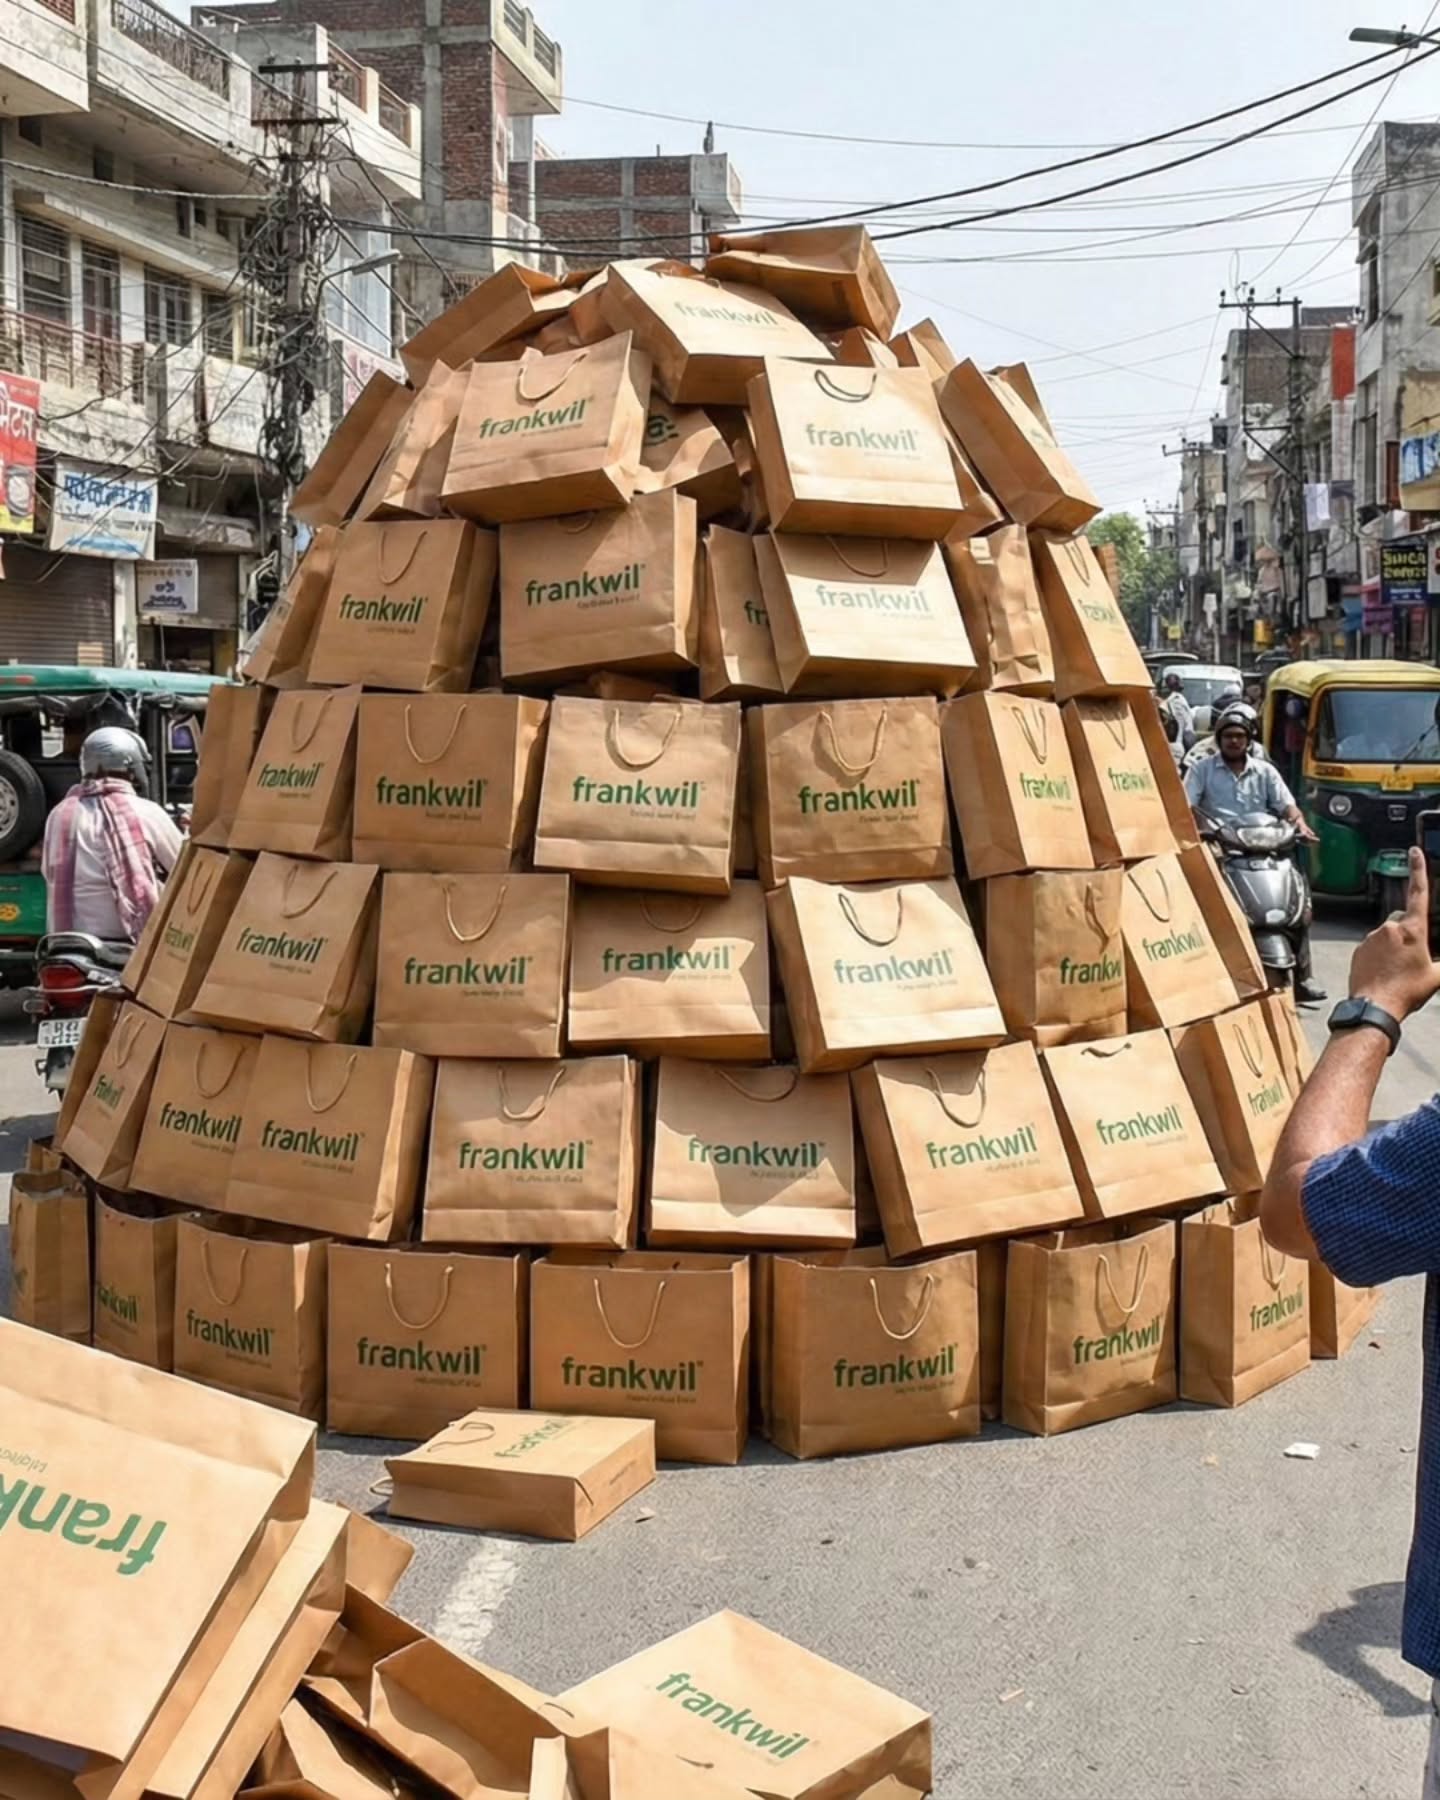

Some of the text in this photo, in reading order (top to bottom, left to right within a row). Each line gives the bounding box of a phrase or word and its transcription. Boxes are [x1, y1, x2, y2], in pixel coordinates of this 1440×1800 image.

[675, 301, 779, 326] frankwil
[479, 400, 588, 438] frankwil
[806, 425, 915, 450] frankwil
[525, 565, 638, 604] frankwil
[815, 584, 931, 613] frankwil
[338, 596, 423, 623] frankwil
[377, 777, 482, 807] frankwil
[573, 776, 697, 807] frankwil
[798, 781, 916, 815] frankwil
[236, 928, 324, 962] frankwil
[602, 946, 731, 972] frankwil
[405, 957, 524, 984] frankwil
[834, 950, 952, 984] frankwil
[159, 1104, 240, 1143] frankwil
[262, 1120, 358, 1160] frankwil
[1096, 1109, 1182, 1144] frankwil
[460, 1142, 583, 1169] frankwil
[688, 1138, 819, 1168] frankwil
[927, 1127, 1036, 1167] frankwil
[187, 1310, 269, 1356] frankwil
[1072, 1320, 1159, 1365] frankwil
[358, 1337, 479, 1375] frankwil
[834, 1348, 952, 1387] frankwil
[562, 1358, 695, 1390] frankwil
[657, 1674, 809, 1758] frankwil
